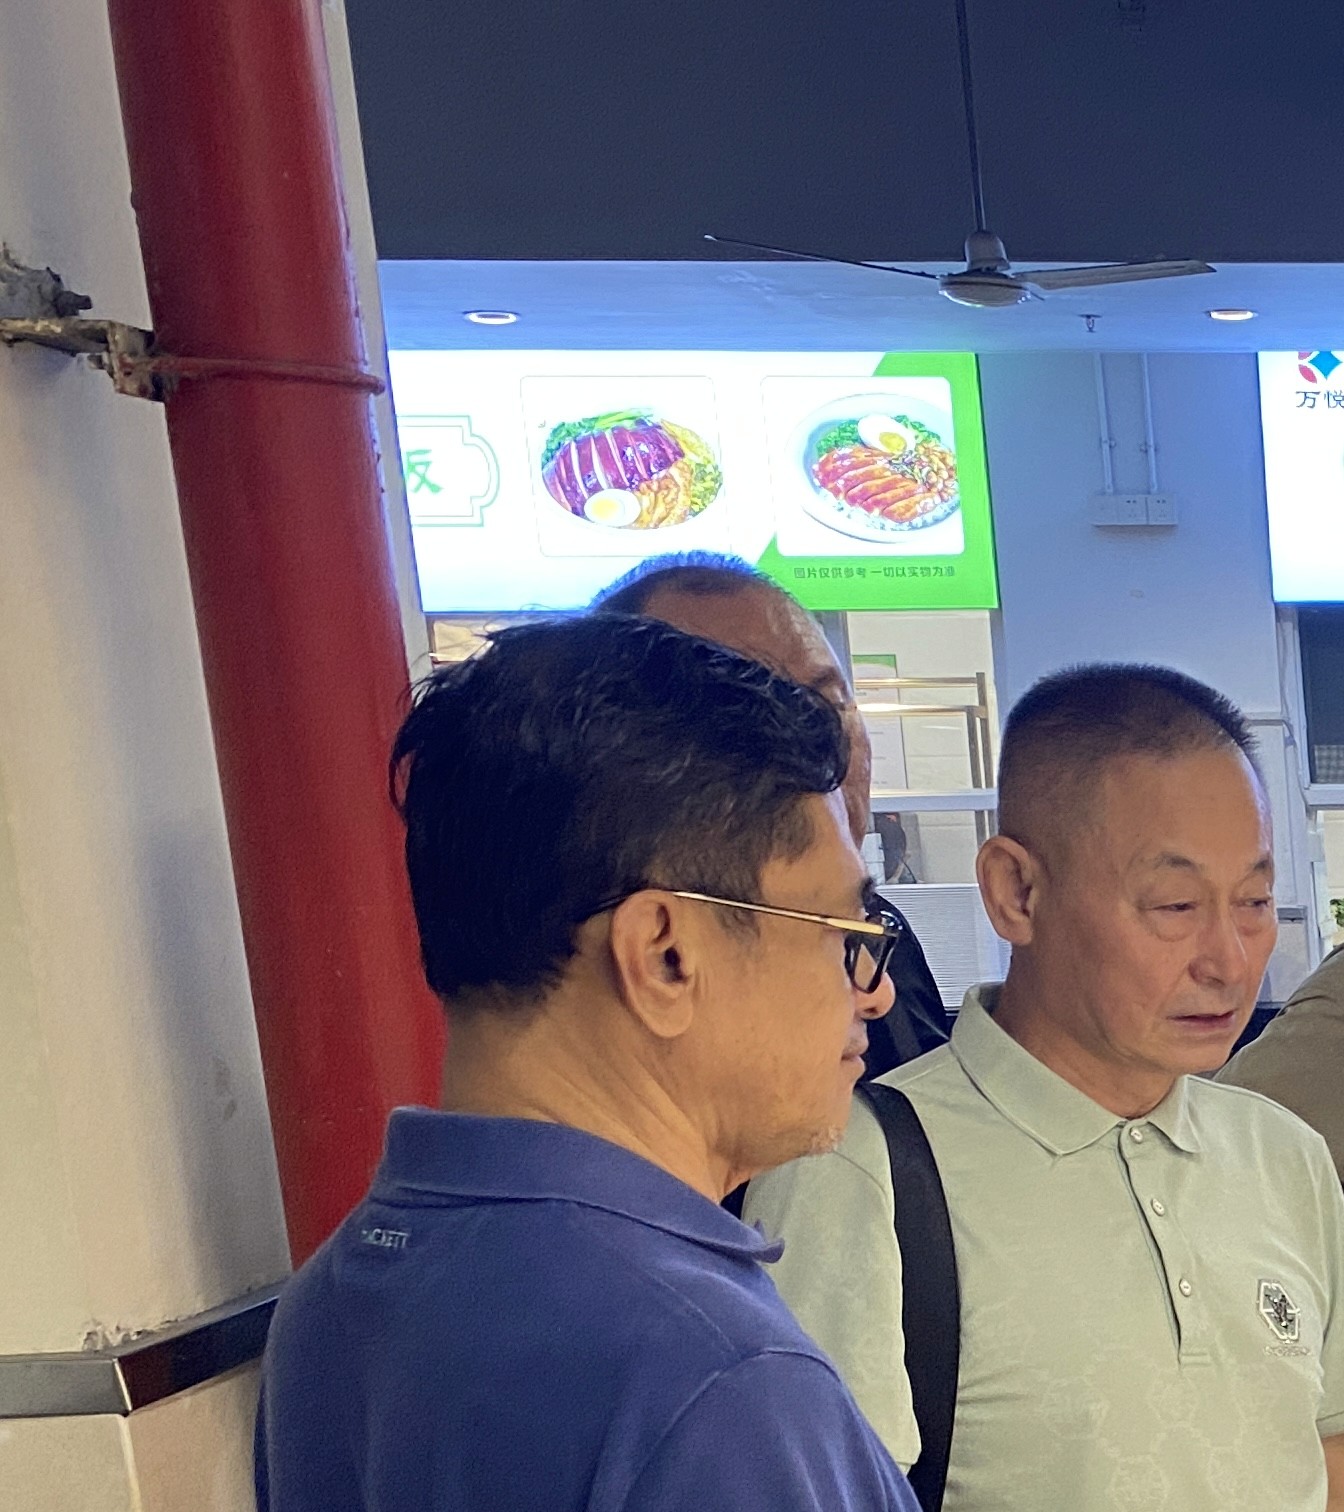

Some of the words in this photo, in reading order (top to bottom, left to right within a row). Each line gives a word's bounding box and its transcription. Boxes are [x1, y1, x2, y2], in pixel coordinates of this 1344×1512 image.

[793, 566, 867, 579] 图片仅供参考
[870, 565, 956, 579] 一切以实物为准
